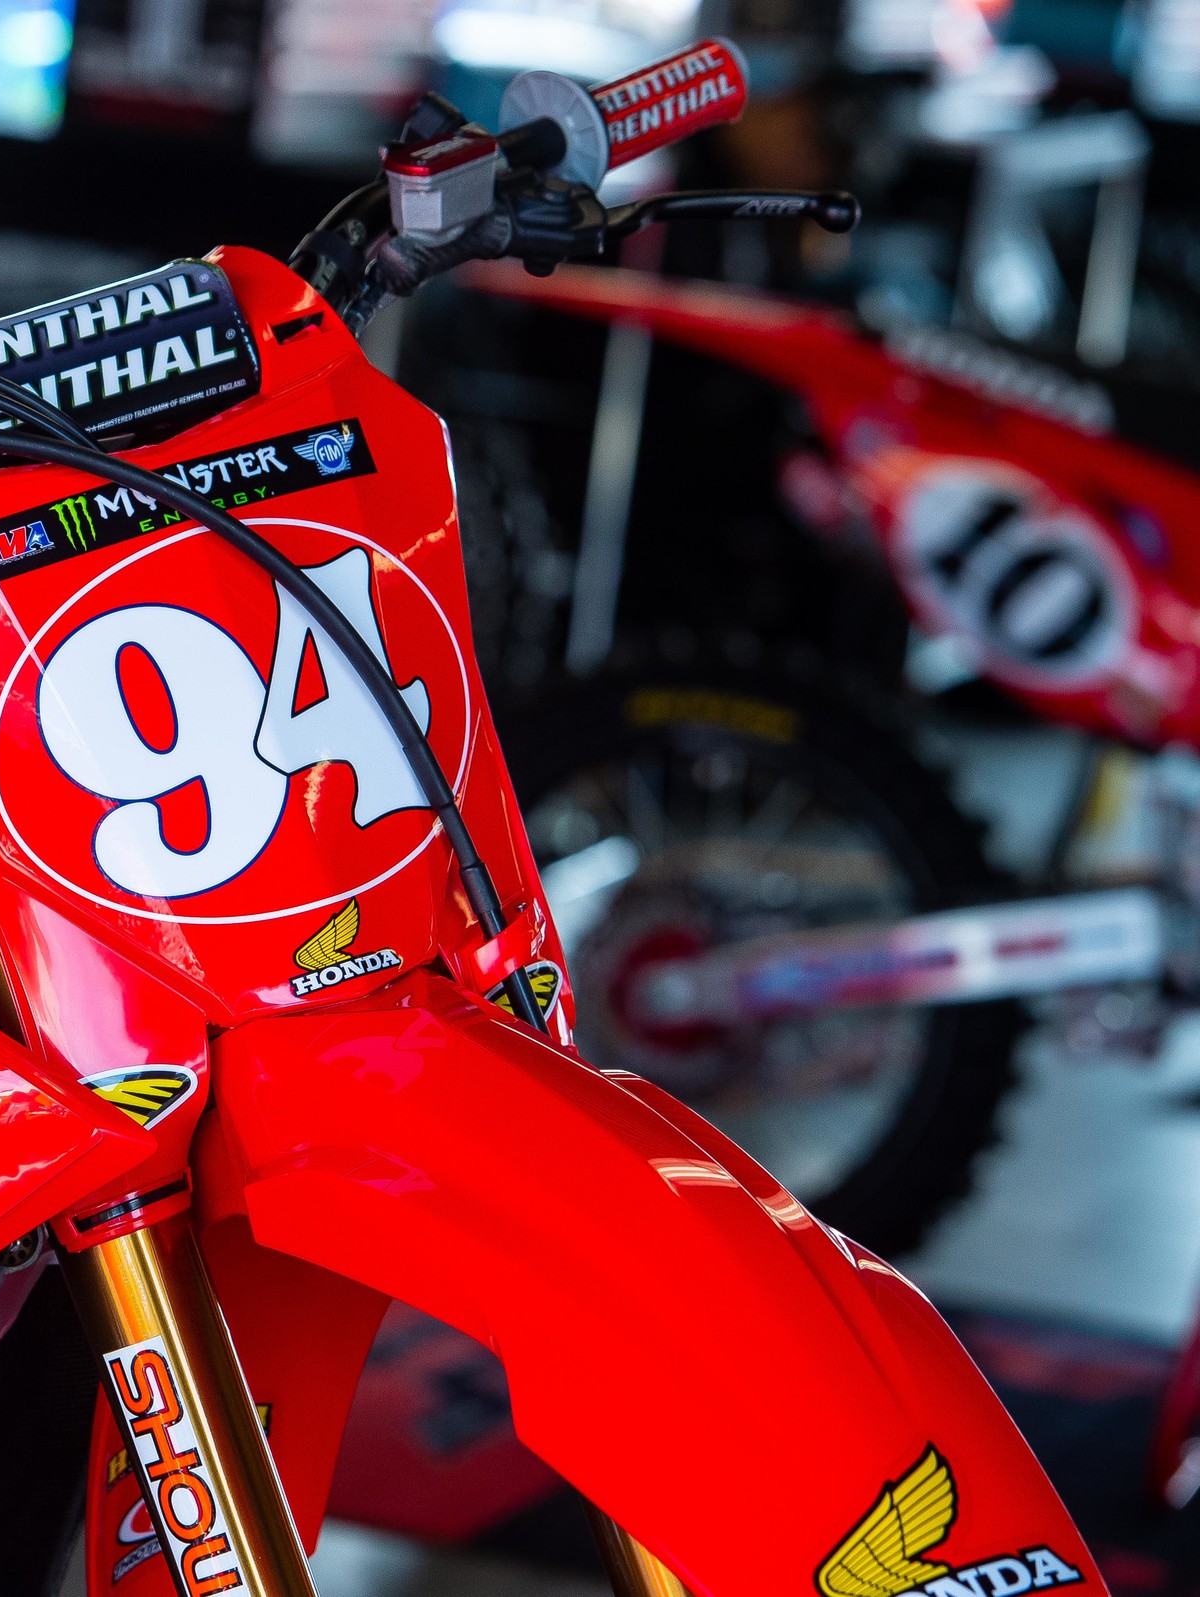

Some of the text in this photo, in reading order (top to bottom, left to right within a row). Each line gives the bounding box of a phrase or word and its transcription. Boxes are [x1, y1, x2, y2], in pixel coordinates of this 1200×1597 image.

[607, 73, 737, 144] RENTHAL
[97, 412, 134, 431] REGISTERED
[134, 401, 170, 419] TRADEMARK
[170, 398, 178, 409] OF
[179, 391, 205, 405] RENTHAL
[318, 444, 341, 462] FIM
[138, 485, 267, 533] ENRGY
[932, 495, 1112, 660] 10
[36, 546, 432, 900] 94
[291, 949, 401, 996] HONDA
